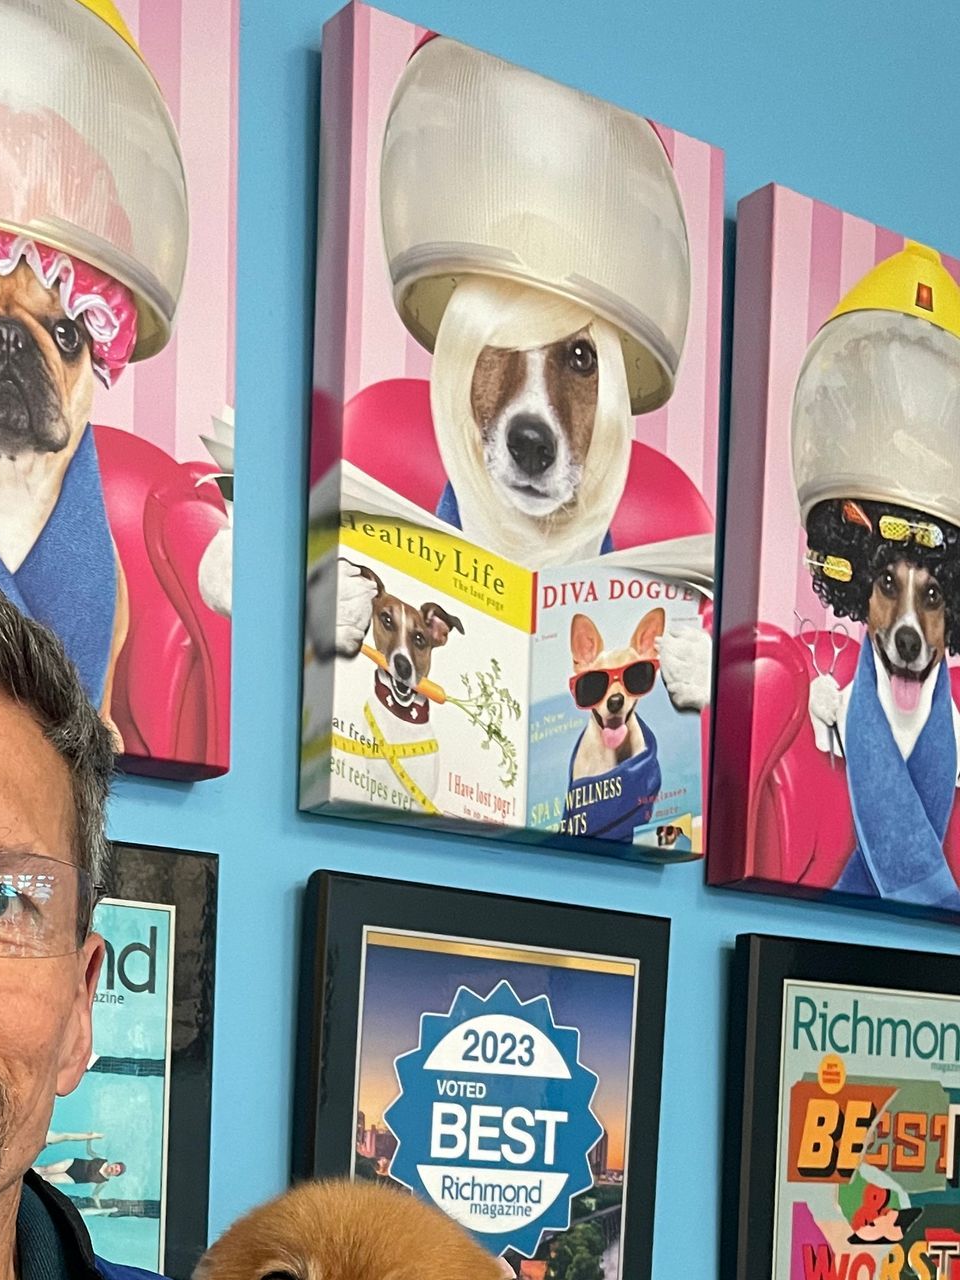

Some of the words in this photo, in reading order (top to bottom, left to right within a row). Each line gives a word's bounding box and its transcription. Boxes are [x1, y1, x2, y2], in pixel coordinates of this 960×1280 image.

[453, 547, 505, 595] Life
[453, 577, 468, 593] The
[486, 595, 504, 612] page
[542, 580, 599, 610] DIVA
[608, 579, 694, 602] DOGUE
[332, 716, 344, 732] at
[349, 723, 380, 754] fresh
[329, 755, 345, 778] est
[349, 766, 388, 801] recipes
[454, 774, 474, 802] Have
[476, 782, 492, 808] lost
[531, 802, 550, 828] SPA
[565, 776, 622, 812] WELLNESS
[93, 992, 125, 1005] azine
[792, 995, 960, 1062] Richmon
[461, 1028, 535, 1067] 2023
[436, 1079, 487, 1099] VOTED
[430, 1101, 569, 1166] BEST
[441, 1174, 543, 1205] Richmond
[469, 1200, 533, 1219] magazine
